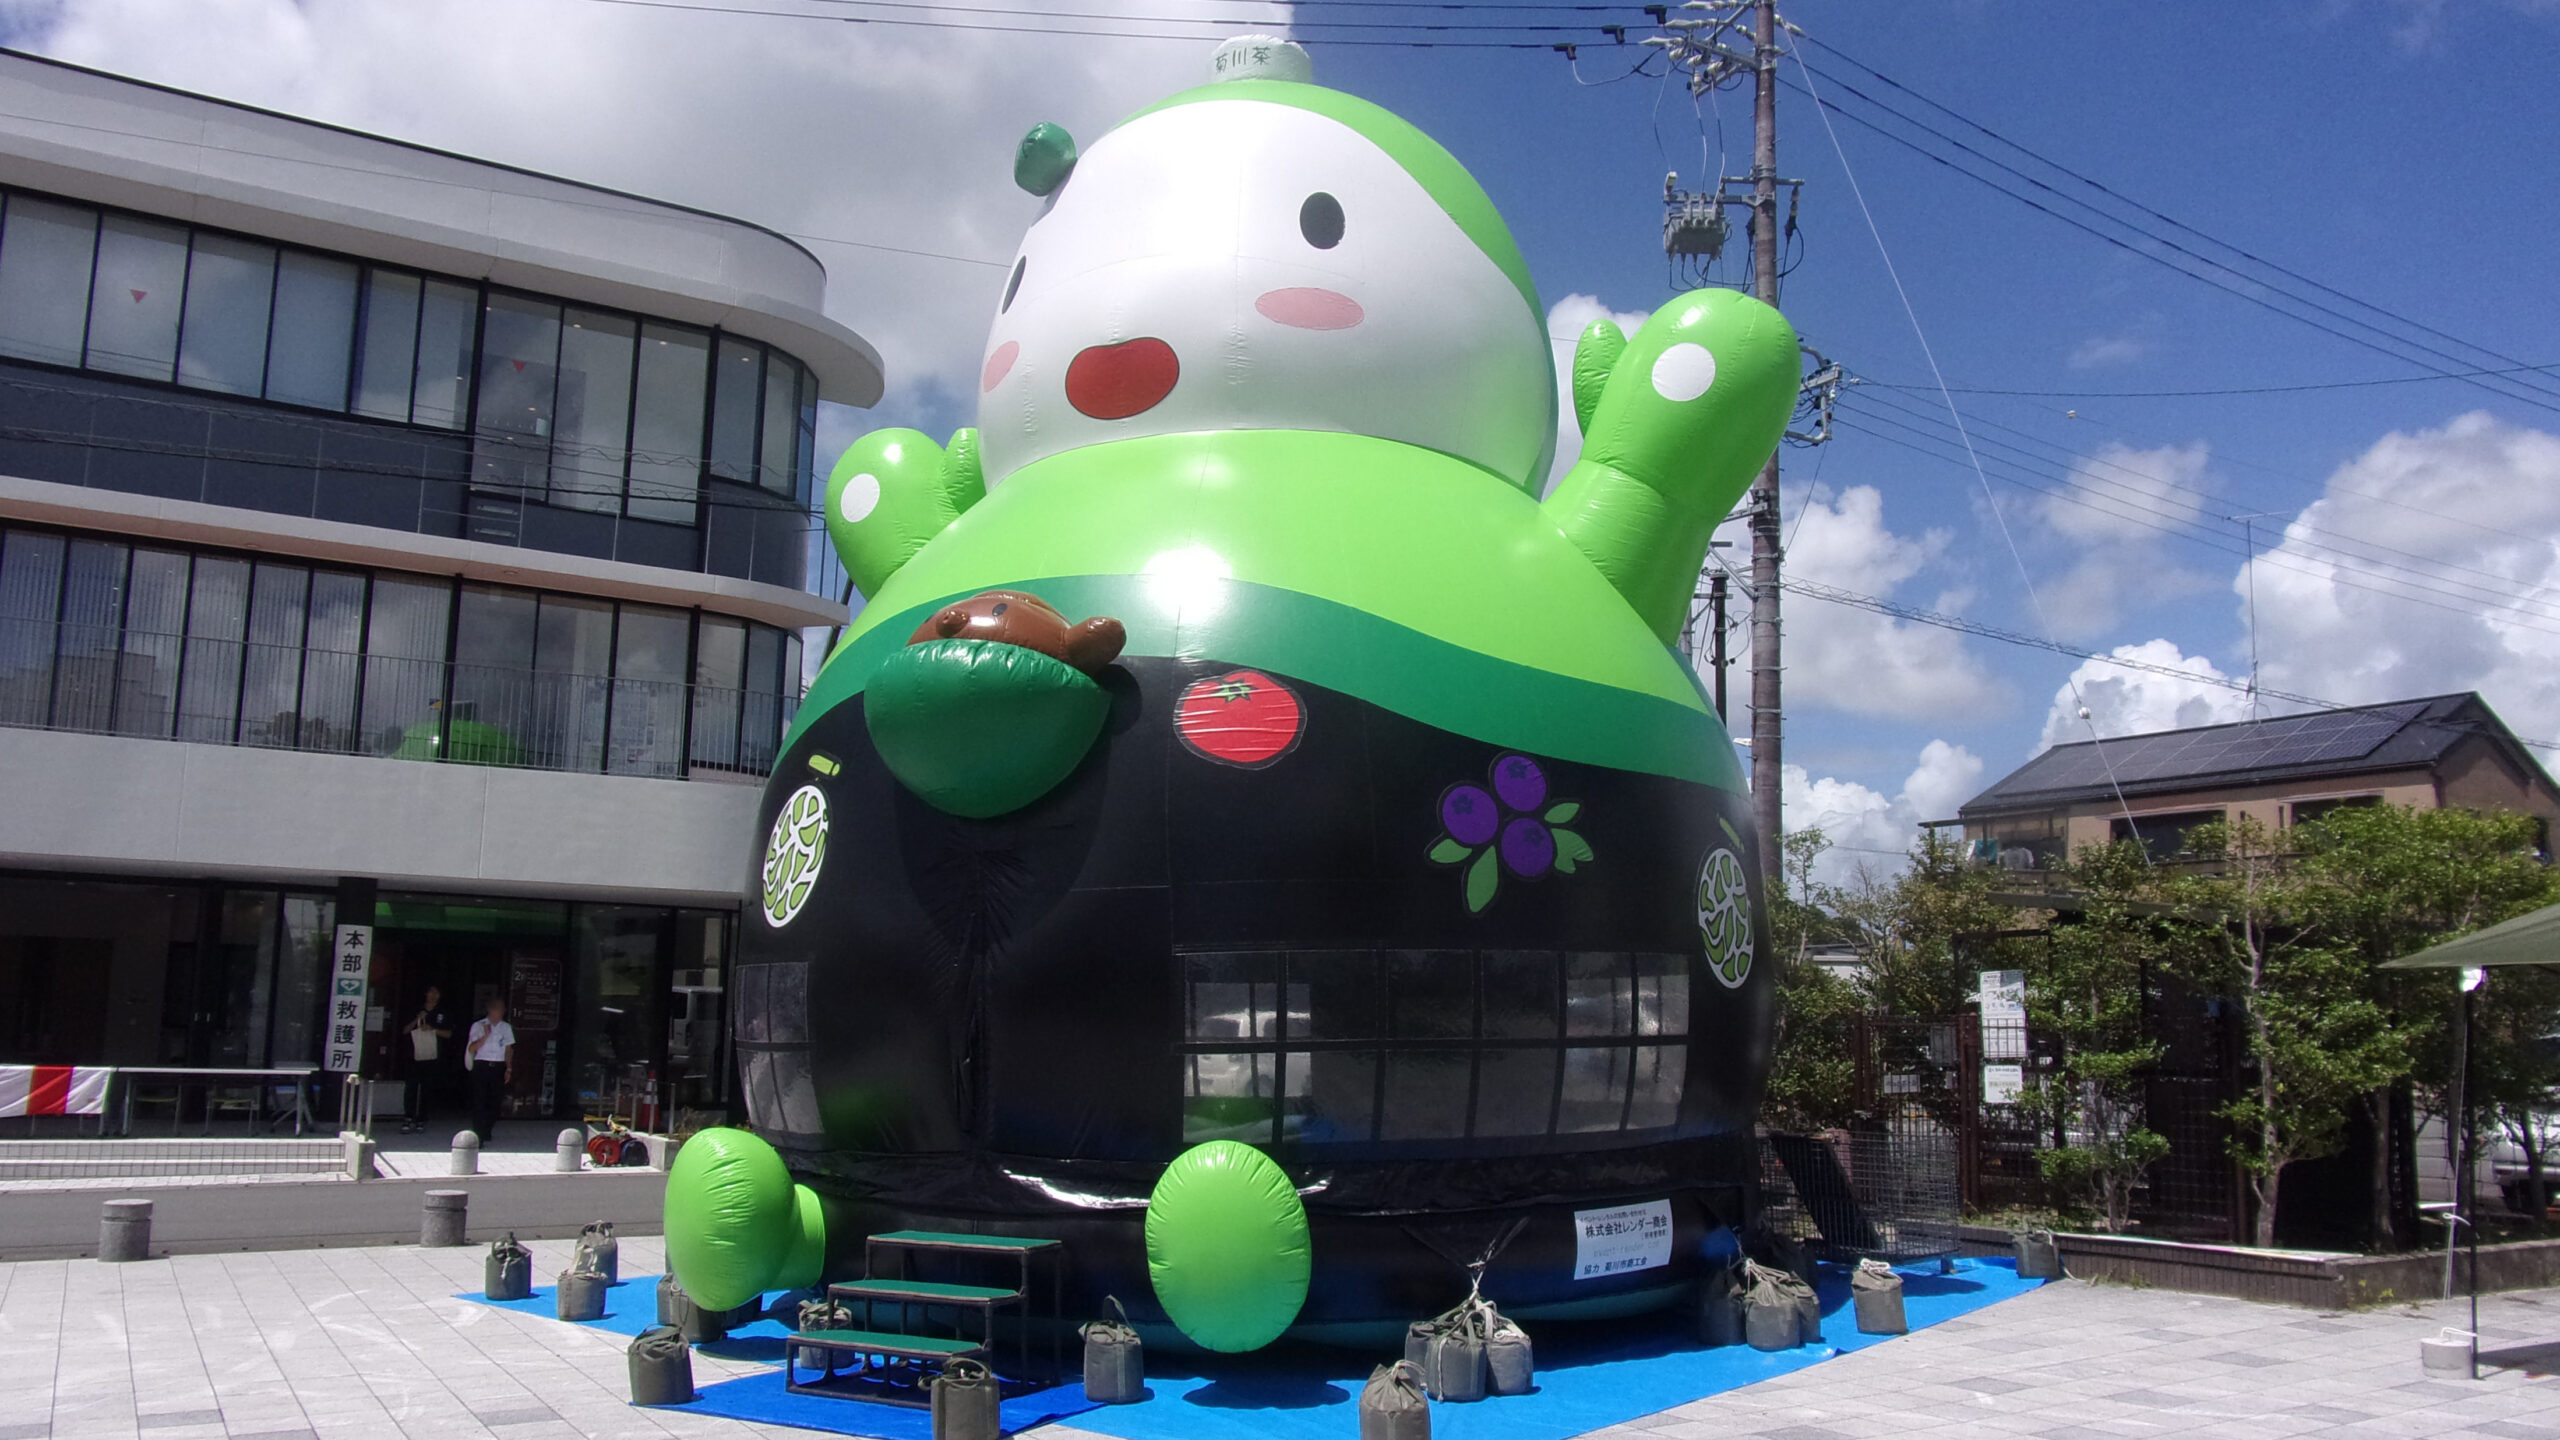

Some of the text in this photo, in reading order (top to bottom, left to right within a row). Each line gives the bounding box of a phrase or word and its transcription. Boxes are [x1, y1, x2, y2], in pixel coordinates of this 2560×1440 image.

[331, 930, 365, 1069] 本部 救護所
[1585, 1214, 1668, 1238] 株式会社レンダー商会
